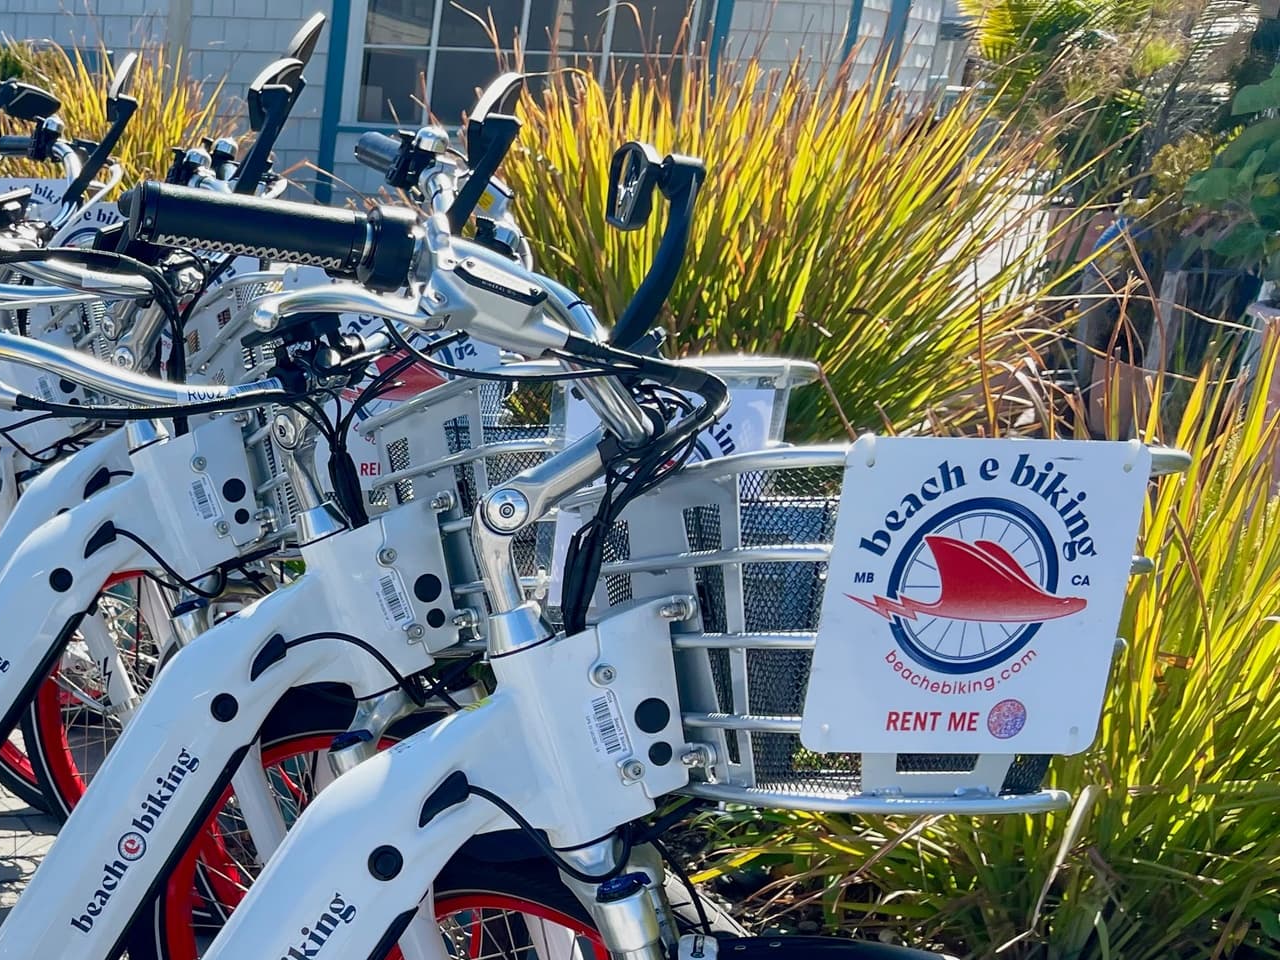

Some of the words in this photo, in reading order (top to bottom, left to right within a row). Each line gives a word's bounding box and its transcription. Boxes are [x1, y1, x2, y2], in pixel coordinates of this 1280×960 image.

[859, 459, 967, 557] beach
[979, 457, 1000, 481] e
[1009, 453, 1098, 563] biking
[853, 571, 875, 584] MB
[1070, 574, 1091, 587] CA
[884, 648, 1038, 695] beachebiking.com
[885, 711, 942, 732] RENT
[947, 711, 980, 732] ME
[70, 859, 129, 934] beach
[131, 747, 200, 834] biking
